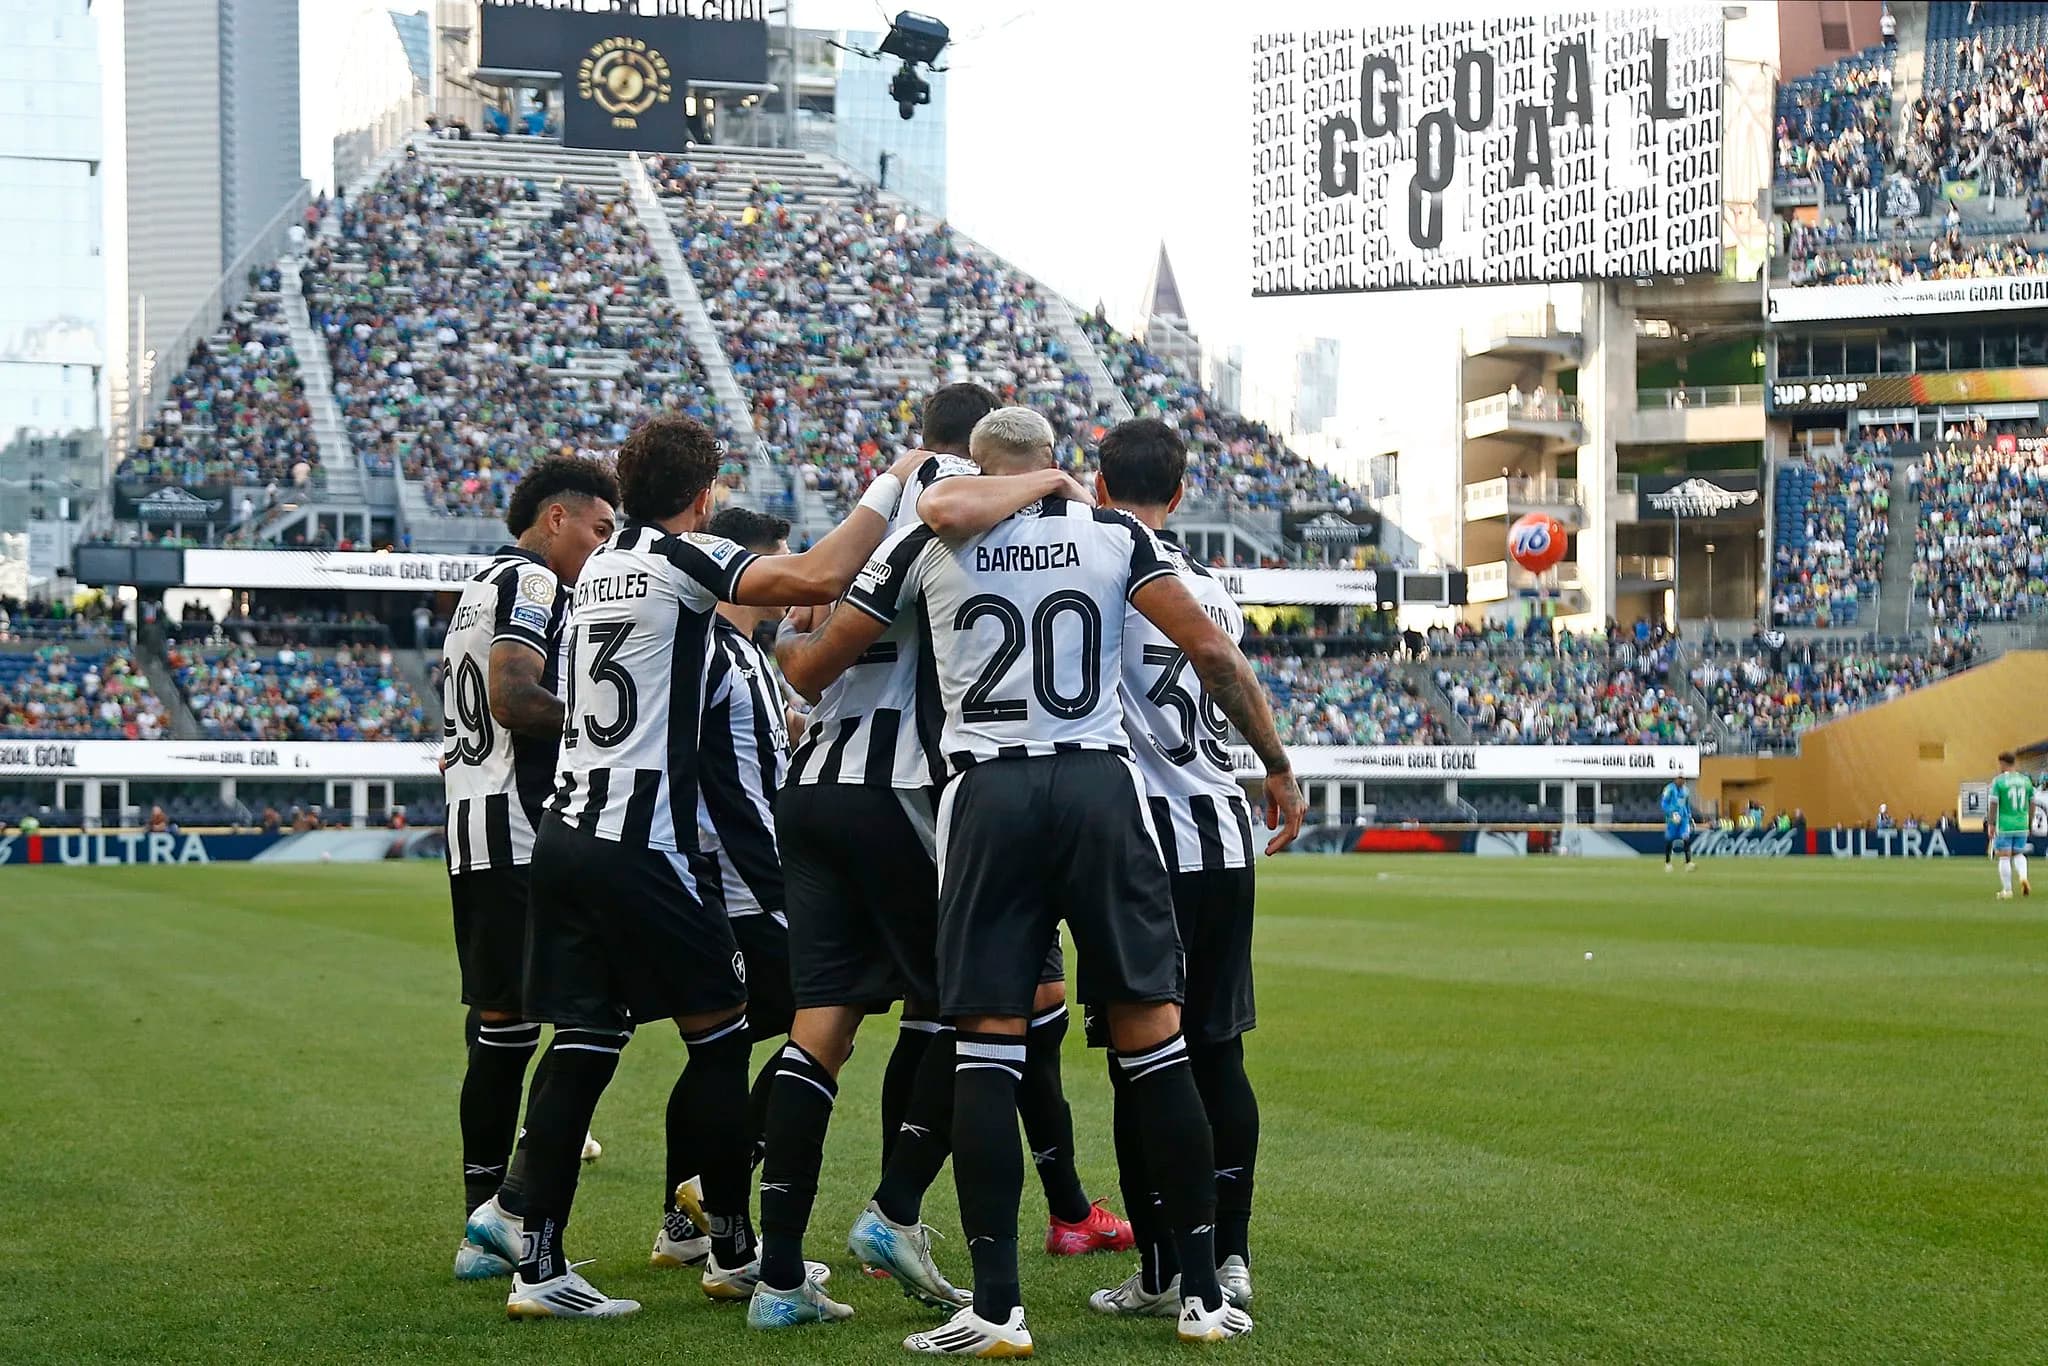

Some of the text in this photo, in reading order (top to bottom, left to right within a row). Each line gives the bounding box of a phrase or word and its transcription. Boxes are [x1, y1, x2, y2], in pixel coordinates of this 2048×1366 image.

[1304, 45, 1355, 84] GOAL
[1487, 33, 1535, 68] OAL
[1304, 76, 1356, 115] GOAL
[1498, 64, 1535, 98] OAL
[1605, 60, 1652, 96] GOA
[1558, 123, 1597, 158] OAL
[1558, 155, 1597, 189] OAL
[1304, 199, 1355, 237] GOAL
[1483, 190, 1535, 228] GOAL
[1543, 187, 1597, 225] GOAL
[1605, 183, 1659, 222] GOAL
[1304, 230, 1355, 268] GOAL
[1483, 221, 1535, 259] GOAL
[1543, 218, 1597, 257] GOAL
[1605, 215, 1659, 254] GOAL
[1970, 285, 2003, 302] GOAL
[1517, 525, 1550, 552] 76
[400, 561, 432, 580] GOAL
[976, 541, 1081, 573] BARBOZA
[592, 572, 649, 603] TELLES
[953, 589, 1102, 724] 20
[565, 622, 638, 750] 13
[36, 746, 77, 767] GOAL
[1232, 752, 1256, 769] OAL
[1408, 752, 1437, 768] GOAL
[1441, 750, 1477, 769] GOAL
[58, 834, 211, 865] ULTRA
[1691, 827, 1951, 857] Michelob ULTRA
